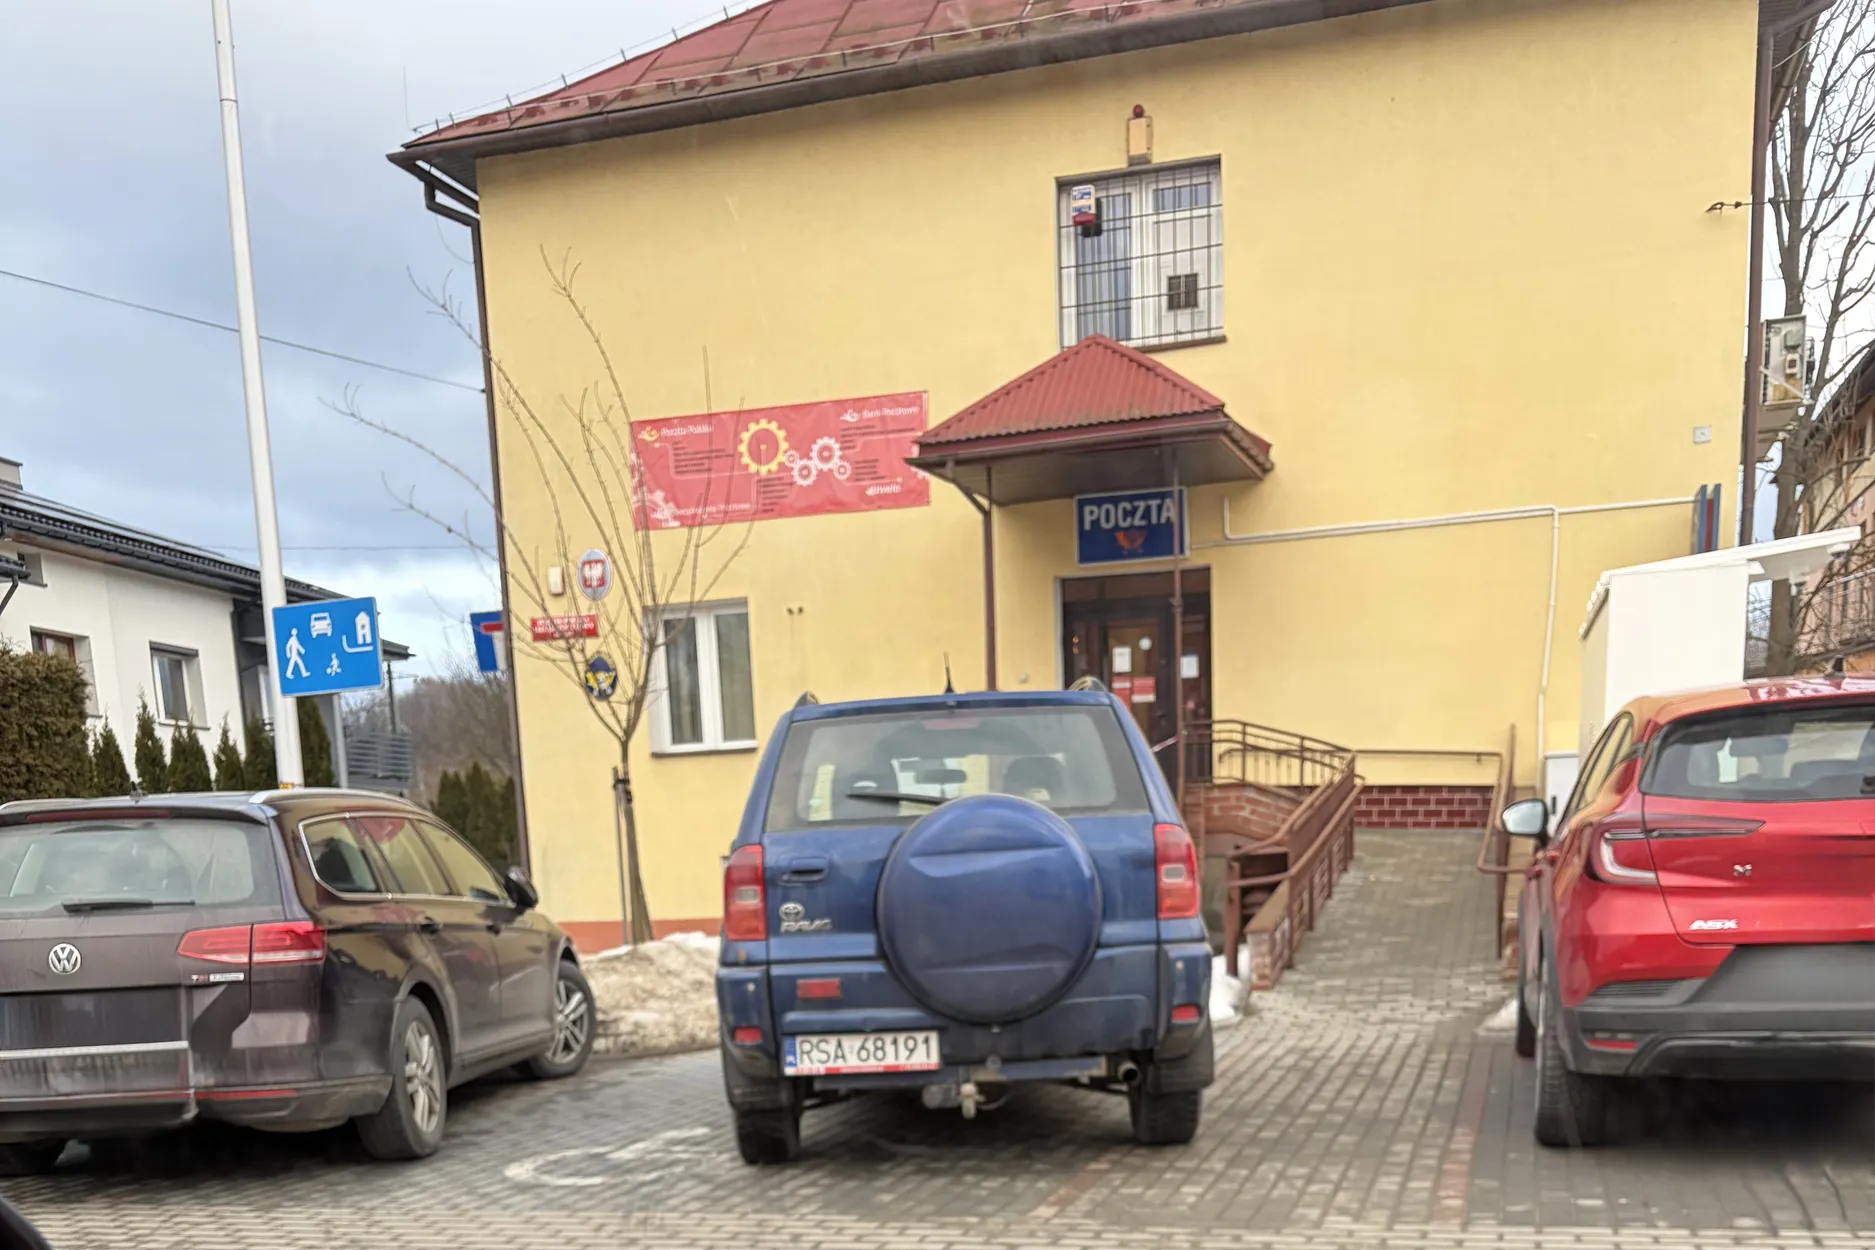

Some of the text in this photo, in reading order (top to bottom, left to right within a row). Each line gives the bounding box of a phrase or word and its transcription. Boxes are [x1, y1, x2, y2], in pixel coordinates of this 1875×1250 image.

[1083, 498, 1175, 531] POCZTA
[1688, 918, 1739, 931] ASX
[799, 1035, 931, 1065] RSA 68191
